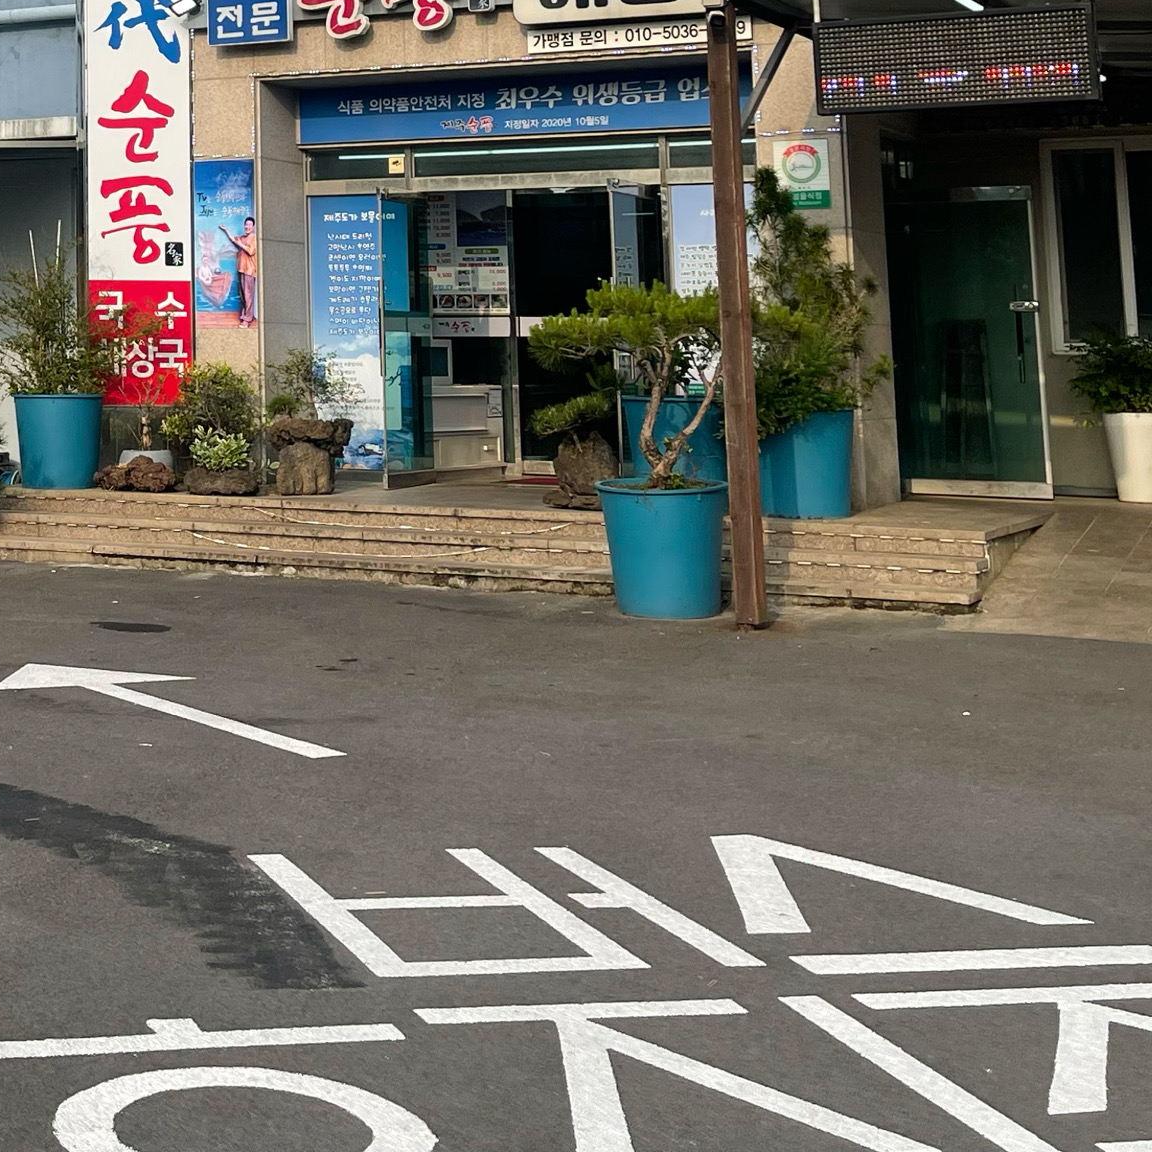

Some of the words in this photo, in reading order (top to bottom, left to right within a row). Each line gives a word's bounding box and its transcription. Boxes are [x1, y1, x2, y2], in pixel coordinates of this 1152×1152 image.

[217, 2, 280, 38] 전문
[534, 30, 574, 48] 가맹점
[580, 30, 607, 45] 문의
[625, 21, 745, 42] 010-5036-9
[337, 100, 364, 115] 식품
[369, 94, 452, 113] 의약품안전처
[457, 92, 485, 109] 지정
[495, 85, 563, 110] 최우수
[572, 79, 667, 107] 위생등급
[504, 119, 539, 129] 지정일자
[541, 117, 572, 127] 2020년
